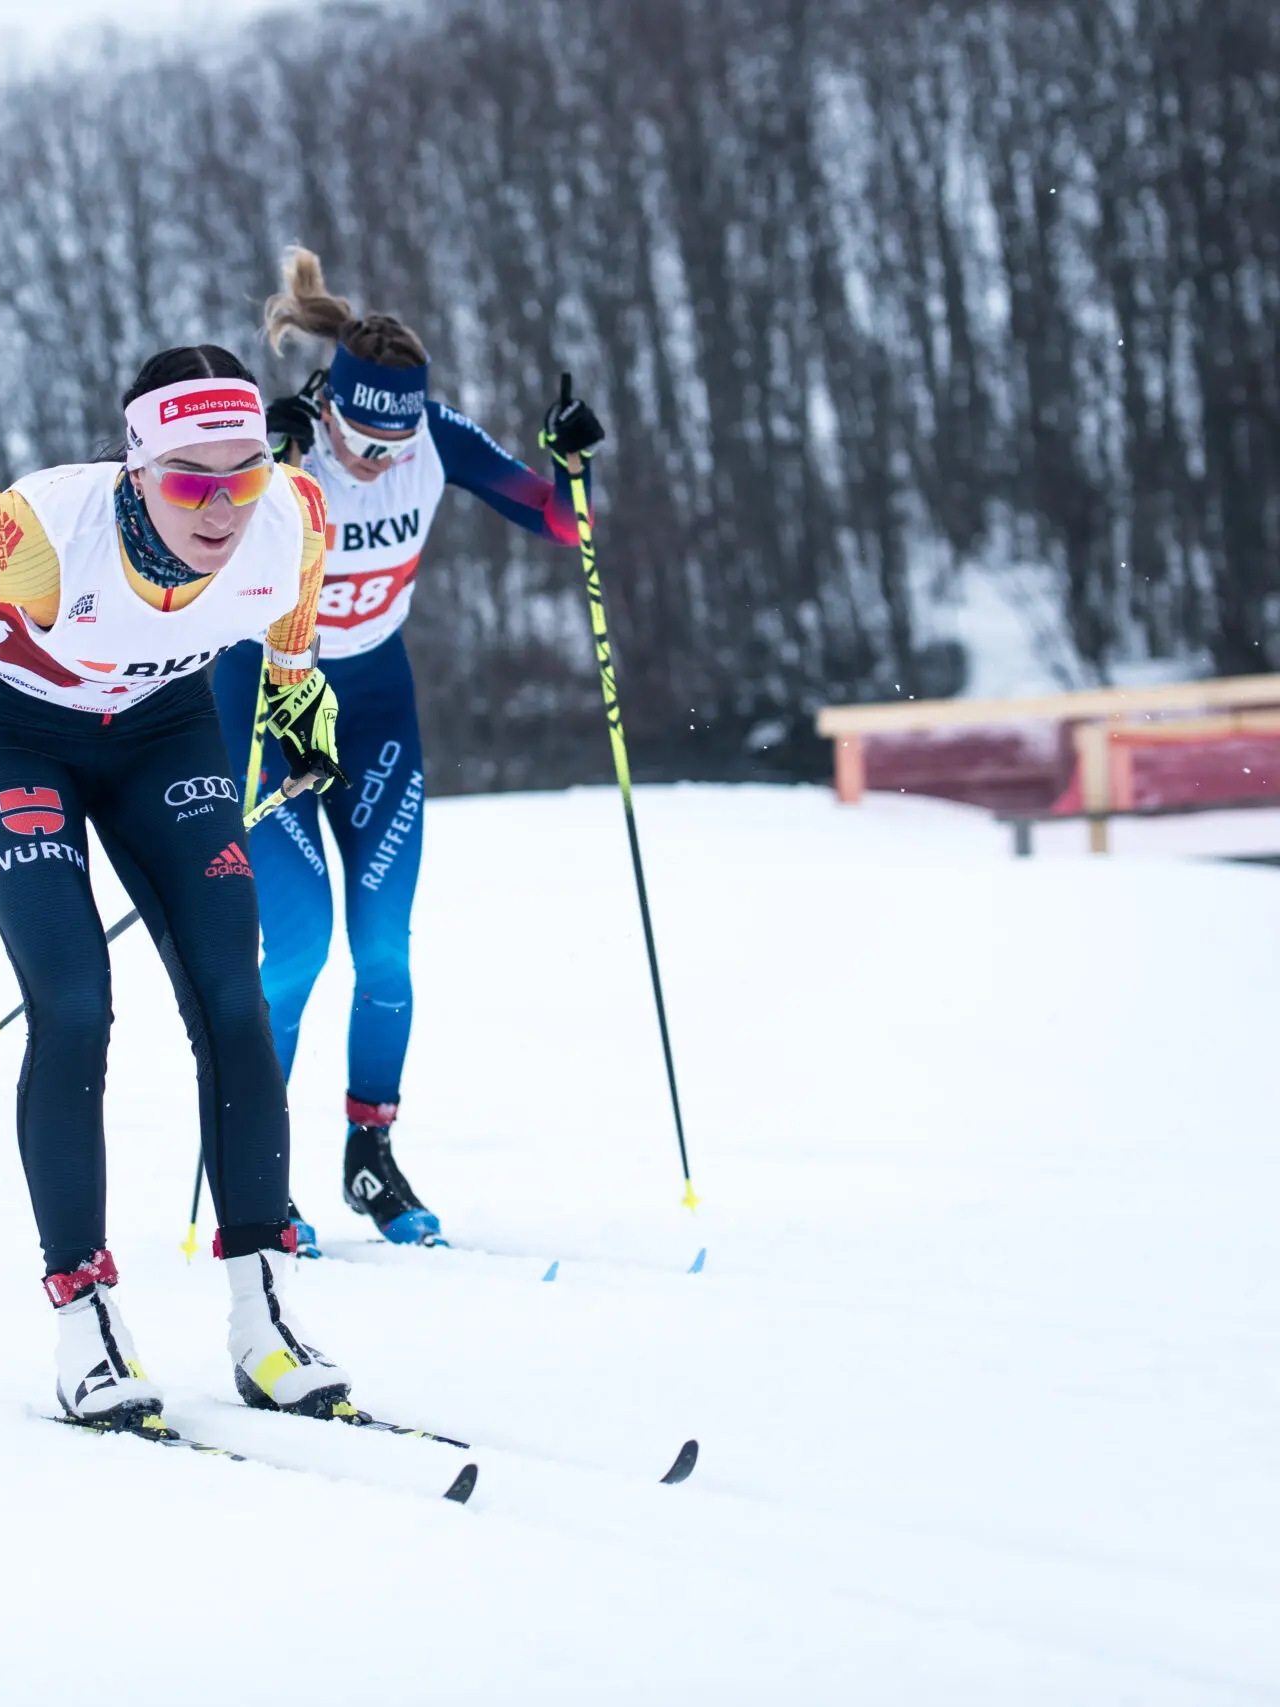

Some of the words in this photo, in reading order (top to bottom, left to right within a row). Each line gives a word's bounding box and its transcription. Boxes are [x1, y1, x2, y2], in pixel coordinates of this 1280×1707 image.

[184, 399, 259, 414] Saalesparkasse
[352, 382, 390, 414] BIO
[342, 508, 420, 551] BKW
[68, 605, 94, 619] CUP
[350, 740, 401, 829] odlo
[176, 804, 215, 822] Audi
[360, 769, 425, 891] RAIFFEISEN
